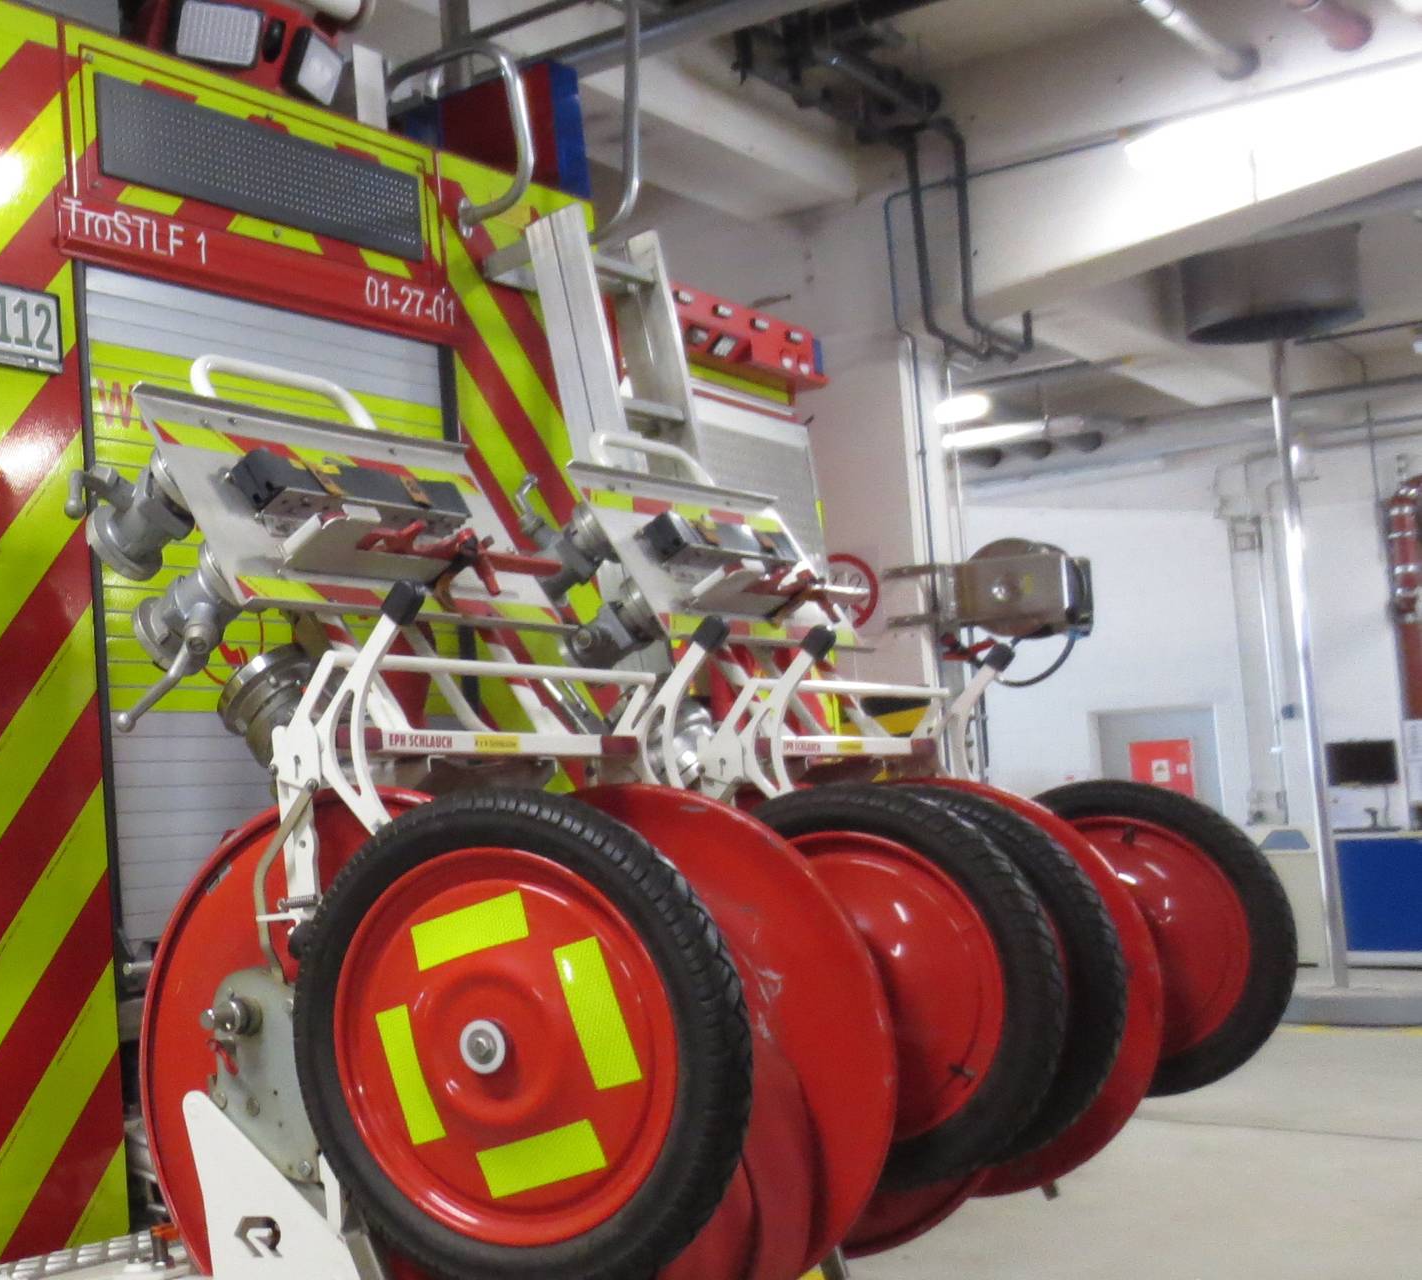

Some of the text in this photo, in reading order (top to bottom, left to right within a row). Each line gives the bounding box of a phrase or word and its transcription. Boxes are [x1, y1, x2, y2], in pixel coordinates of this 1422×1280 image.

[63, 197, 207, 265] TroSTLF 1
[365, 276, 455, 326] 01-27-01
[409, 734, 453, 749] SCHLAUCH
